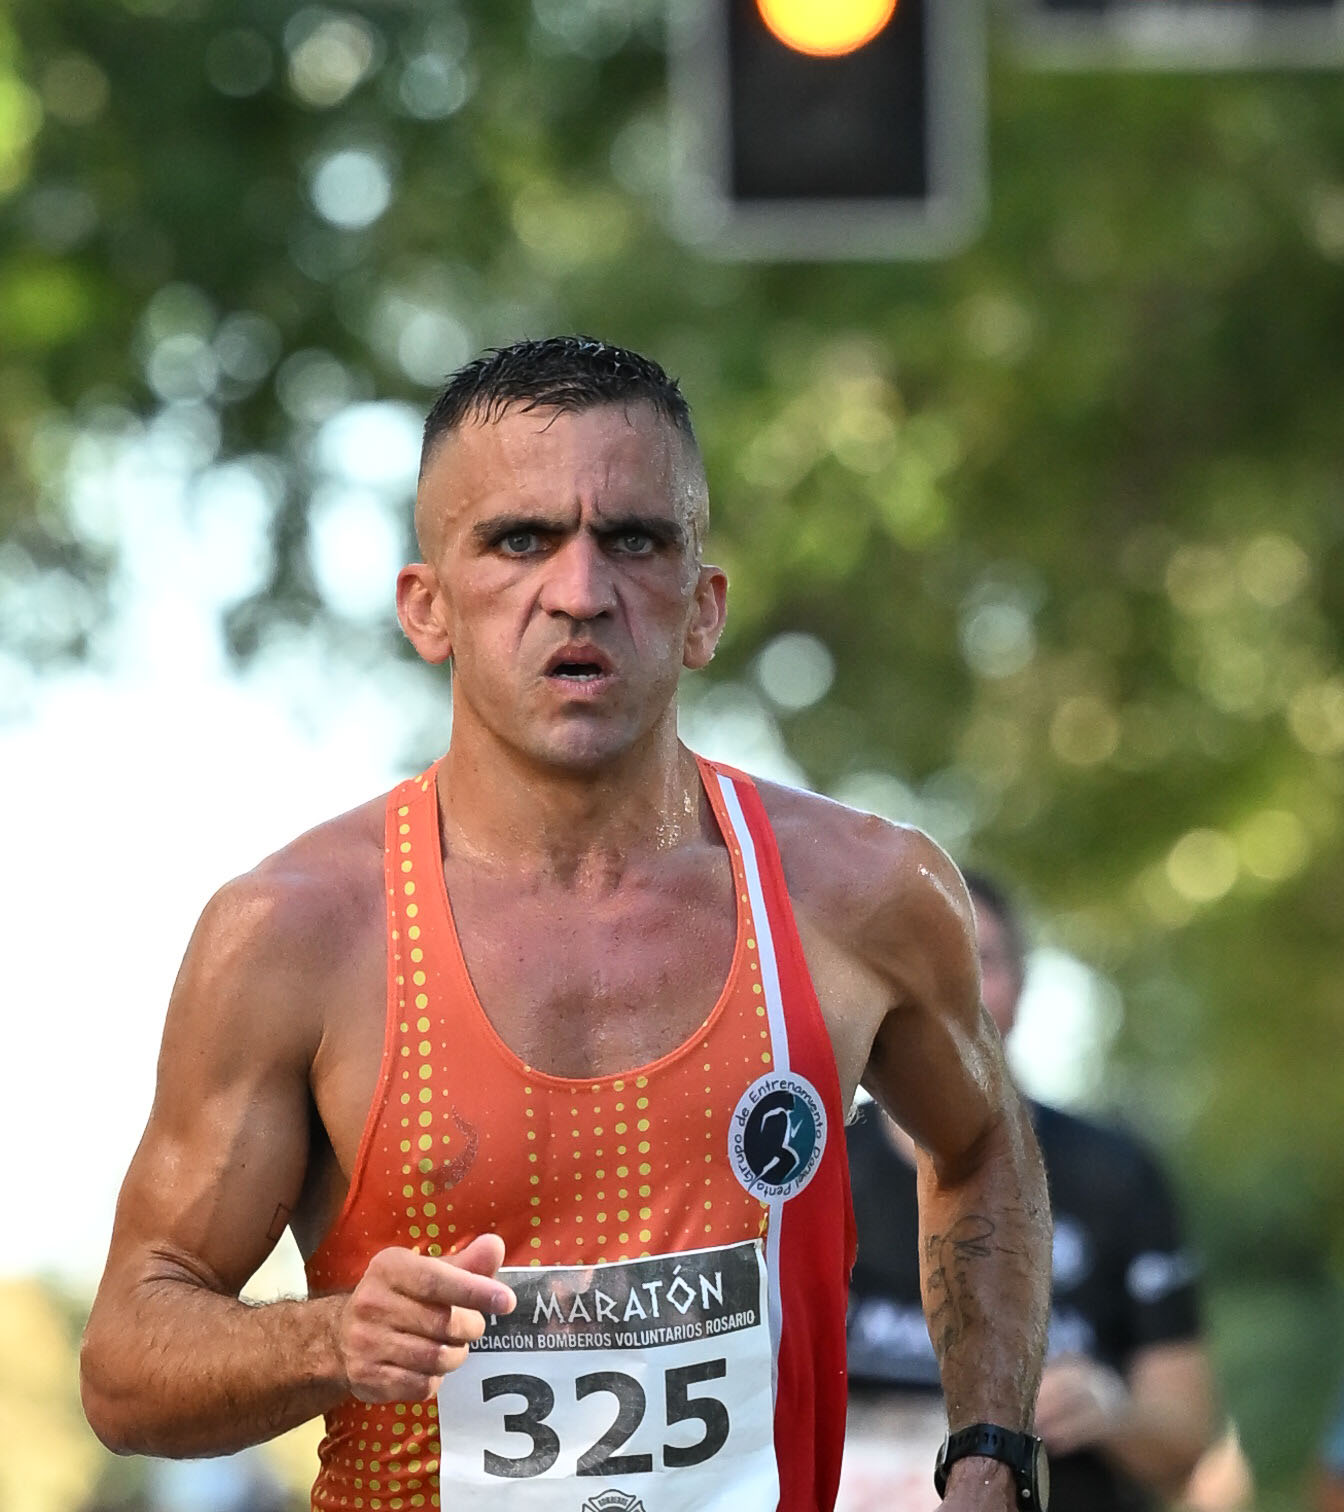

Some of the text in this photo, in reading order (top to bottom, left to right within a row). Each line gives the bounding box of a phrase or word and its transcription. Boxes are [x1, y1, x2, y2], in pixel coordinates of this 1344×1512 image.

[735, 1107, 750, 1127] de
[734, 1133, 754, 1183] Grupo
[532, 1264, 723, 1324] MARATÓN
[537, 1333, 611, 1349] BOMBEROS
[614, 1321, 703, 1347] VOLUNTARIOS
[705, 1309, 755, 1336] ROSARIO
[481, 1357, 731, 1479] 325
